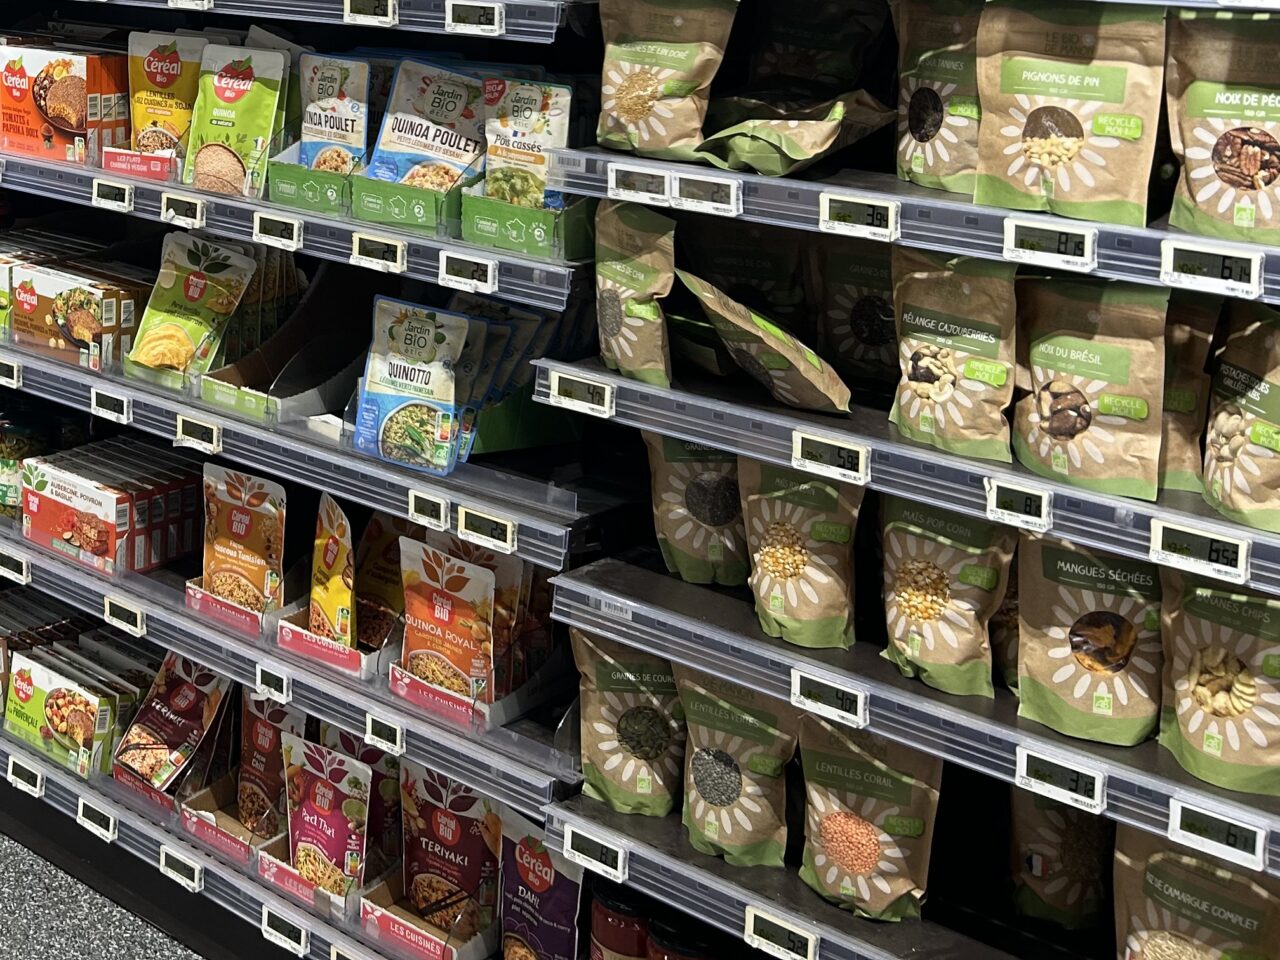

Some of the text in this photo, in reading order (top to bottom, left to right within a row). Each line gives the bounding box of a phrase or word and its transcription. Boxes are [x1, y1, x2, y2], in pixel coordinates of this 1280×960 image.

[144, 56, 181, 75] Céréal
[3, 71, 28, 89] Céréal
[156, 74, 167, 84] Bio
[213, 71, 253, 91] Céréal
[317, 72, 338, 85] Jardin
[1022, 70, 1100, 88] PIGNONS DE PIN
[146, 90, 175, 100] LENTILLES
[224, 88, 236, 98] Bio
[431, 86, 462, 101] Jardin
[511, 92, 536, 106] Jardin
[1215, 92, 1280, 107] NOIX DE PÉC
[143, 97, 168, 108] CUISINÉS
[175, 100, 192, 110] SOJA
[213, 107, 236, 118] QUINOA
[2, 113, 25, 125] TOMATES
[324, 115, 356, 133] POULET
[1097, 115, 1136, 127] RECYCLE
[2, 124, 39, 138] PAPRIKA DOUX
[391, 116, 481, 154] QUINOA POULET
[494, 134, 541, 153] Pois cassés
[15, 288, 38, 306] Céréal
[188, 286, 201, 298] BIO
[404, 320, 430, 336] Jardin
[903, 311, 996, 344] MÉLANGE CAJOUBERRIES
[1039, 342, 1102, 365] NOIX DU BRÉSIL
[388, 362, 431, 385] QUINOTTO
[970, 360, 1002, 374] RECYCLE
[1103, 396, 1141, 409] RECYCLE
[55, 490, 73, 503] BASILIC
[80, 493, 103, 508] POIVRON
[231, 509, 250, 525] Céréal
[903, 509, 971, 537] MAÏS POP CORN
[233, 521, 246, 535] BIO
[213, 543, 266, 566] ouscous Tunisien
[1057, 560, 1153, 587] MANGUES SÉCHÉES
[432, 592, 452, 608] Céréal
[434, 604, 449, 622] BIO
[1242, 605, 1271, 624] CHIPS
[405, 613, 477, 651] QUINOA ROYAL
[611, 670, 640, 682] GRAINES
[642, 672, 651, 682] DE
[13, 675, 34, 696] Céréal
[12, 706, 38, 729] PROVENÇALE
[690, 701, 728, 720] LENTILLES
[258, 735, 270, 748] BIO
[815, 761, 893, 789] LENTILLES CORAIL
[315, 782, 334, 800] Céréal
[315, 794, 329, 810] BIO
[302, 808, 317, 826] Pad
[437, 811, 455, 830] Céréal
[438, 824, 453, 841] BIO
[420, 837, 469, 866] TERIYAKI
[515, 843, 555, 886] Céréal
[527, 871, 540, 887] Bio
[517, 885, 541, 910] DAHL
[1155, 876, 1163, 888] DE
[1163, 881, 1210, 912] CAMARGUE
[1210, 905, 1259, 932] COMPLET
[390, 922, 441, 955] LES CUISINÉS
